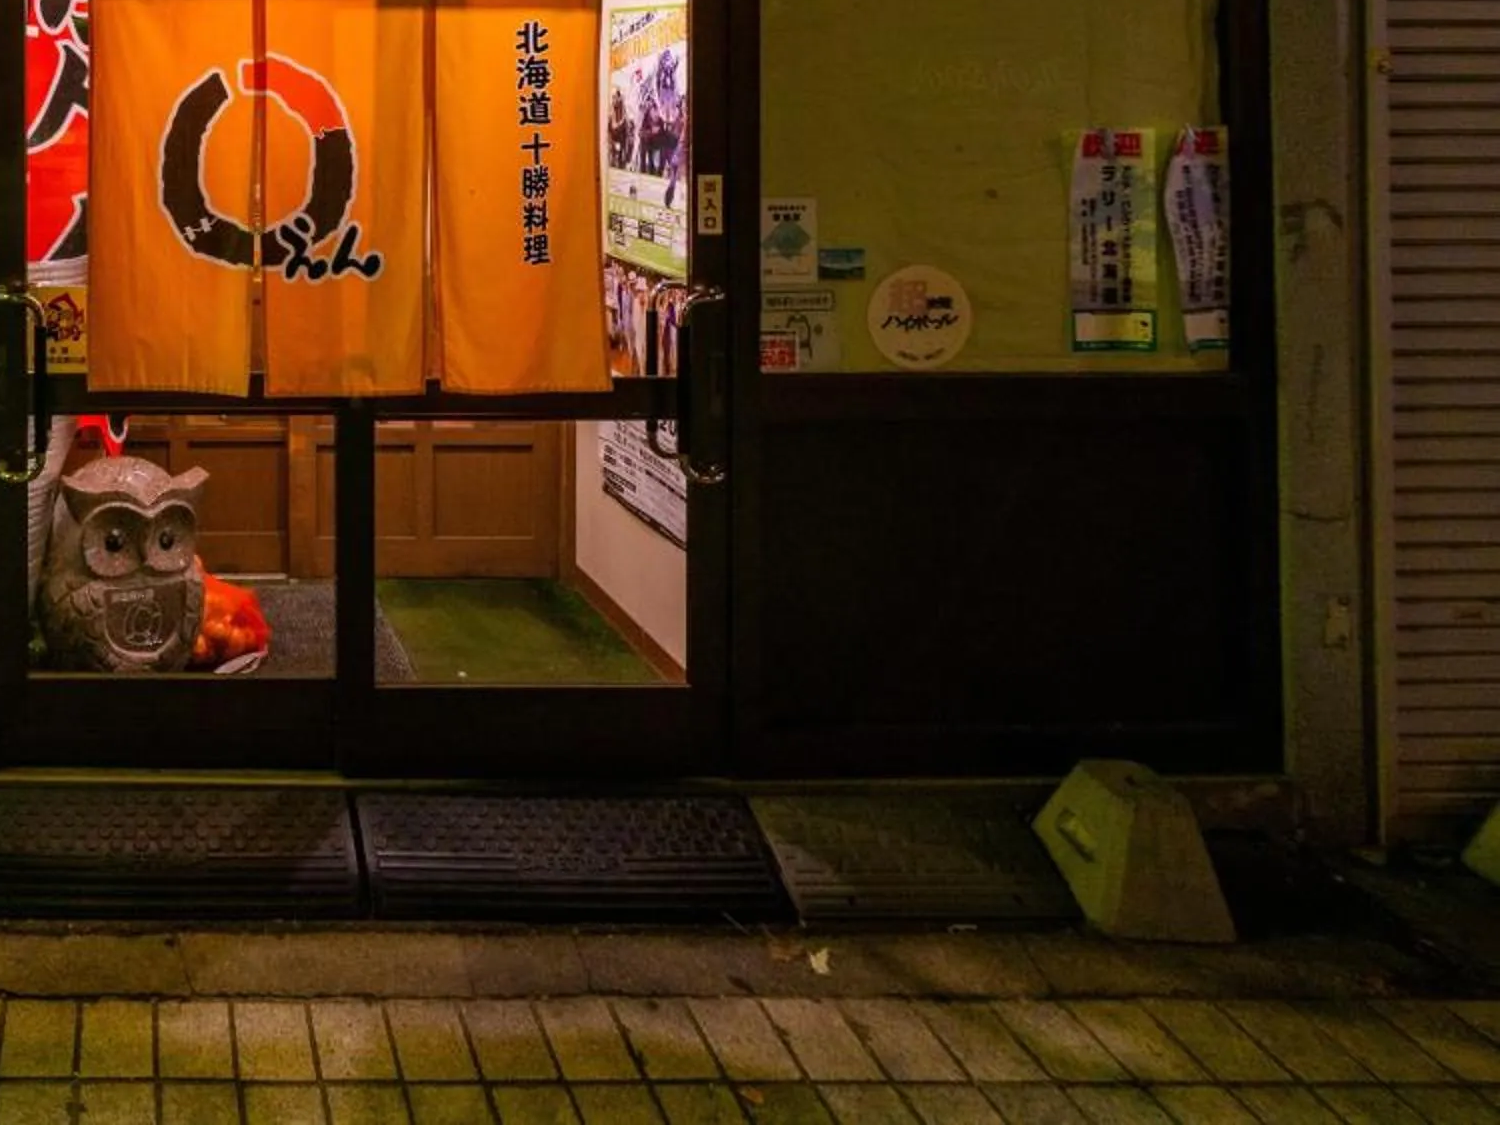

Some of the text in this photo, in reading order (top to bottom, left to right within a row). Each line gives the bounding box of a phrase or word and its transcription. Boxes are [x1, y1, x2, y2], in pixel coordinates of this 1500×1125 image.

[515, 21, 552, 266] 北海道十勝料理
[278, 214, 382, 280] えん
